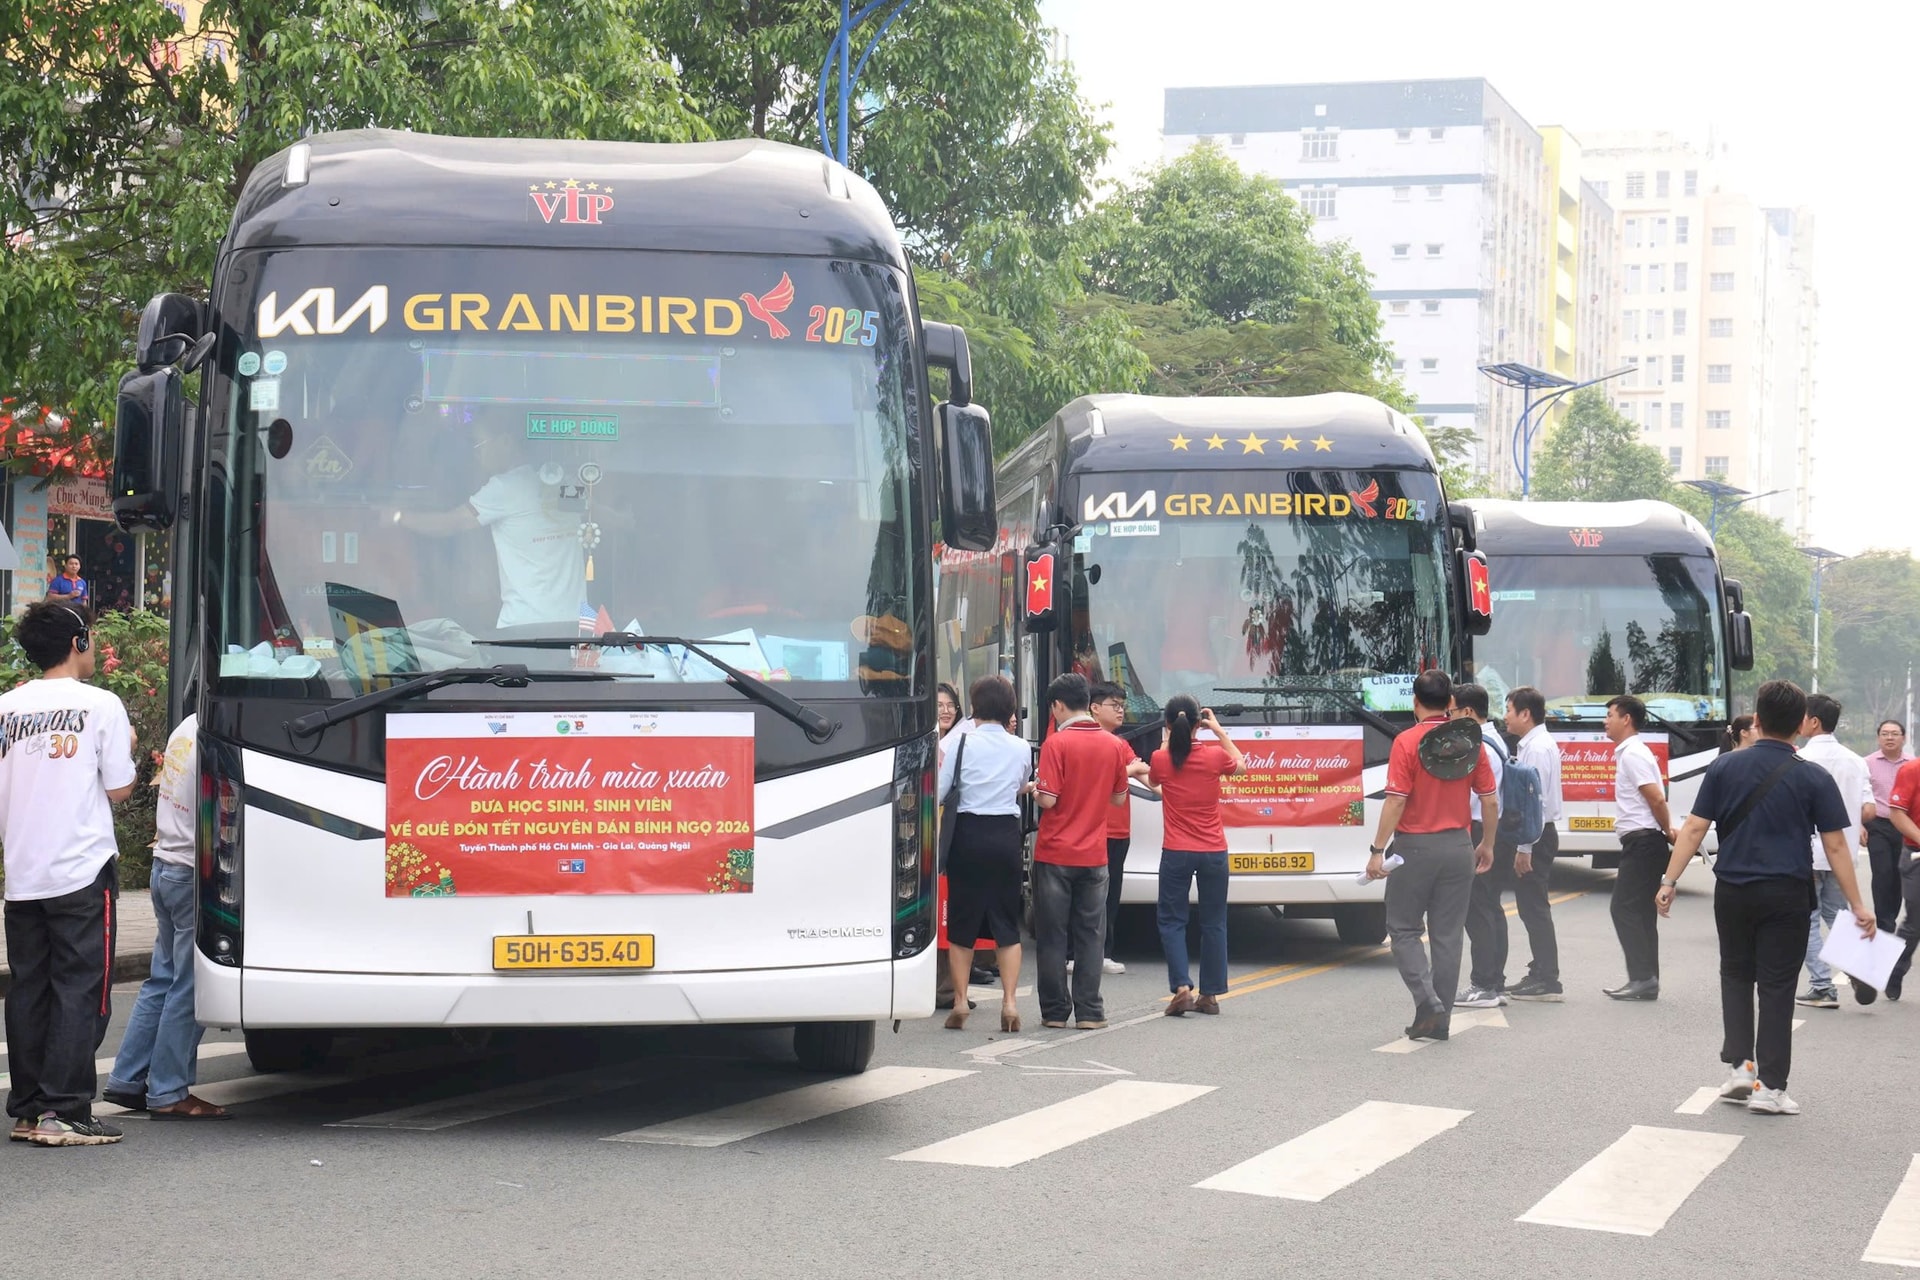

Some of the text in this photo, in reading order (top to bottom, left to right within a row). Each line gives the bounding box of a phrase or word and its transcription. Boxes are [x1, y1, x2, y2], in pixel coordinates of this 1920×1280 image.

[530, 187, 614, 224] VIP
[258, 284, 880, 347] KIA GRANBIRD 2025
[531, 419, 547, 433] XE
[551, 418, 576, 437] HỢP
[1084, 490, 1426, 521] KIA GRANBIRD 2025
[1113, 525, 1122, 533] XE
[1123, 524, 1137, 533] HỢP
[1569, 530, 1604, 548] VIP
[0, 709, 89, 759] WARRIORS
[48, 734, 78, 759] 30
[1280, 754, 1313, 769] mùa
[1314, 755, 1350, 771] xuân
[1583, 749, 1609, 763] trình
[414, 755, 730, 800] Hành trình mùa xuân
[1229, 774, 1248, 784] HỌC
[1276, 773, 1297, 782] SINH
[1298, 771, 1319, 782] VIÊN
[1221, 784, 1237, 794] TẾT
[1238, 784, 1275, 794] NGUYÊN
[1278, 784, 1296, 793] ĐÁN
[1320, 785, 1340, 795] NGỌ
[1342, 785, 1361, 793] 2026
[471, 796, 672, 816] ĐƯA HỌC SINH, SINH VIÊN
[390, 818, 750, 837] VỀ QUÊ ĐÓN TẾT NGUYÊN ĐÁN BÍNH NGỌ 2026
[1574, 820, 1615, 828] 50H-551.
[553, 842, 569, 851] Chí
[571, 841, 594, 851] Minh
[602, 841, 619, 851] Gia
[1234, 856, 1306, 869] 50H-668.92
[787, 926, 884, 939] TRACOMECO
[506, 940, 641, 963] 50H-635.40
